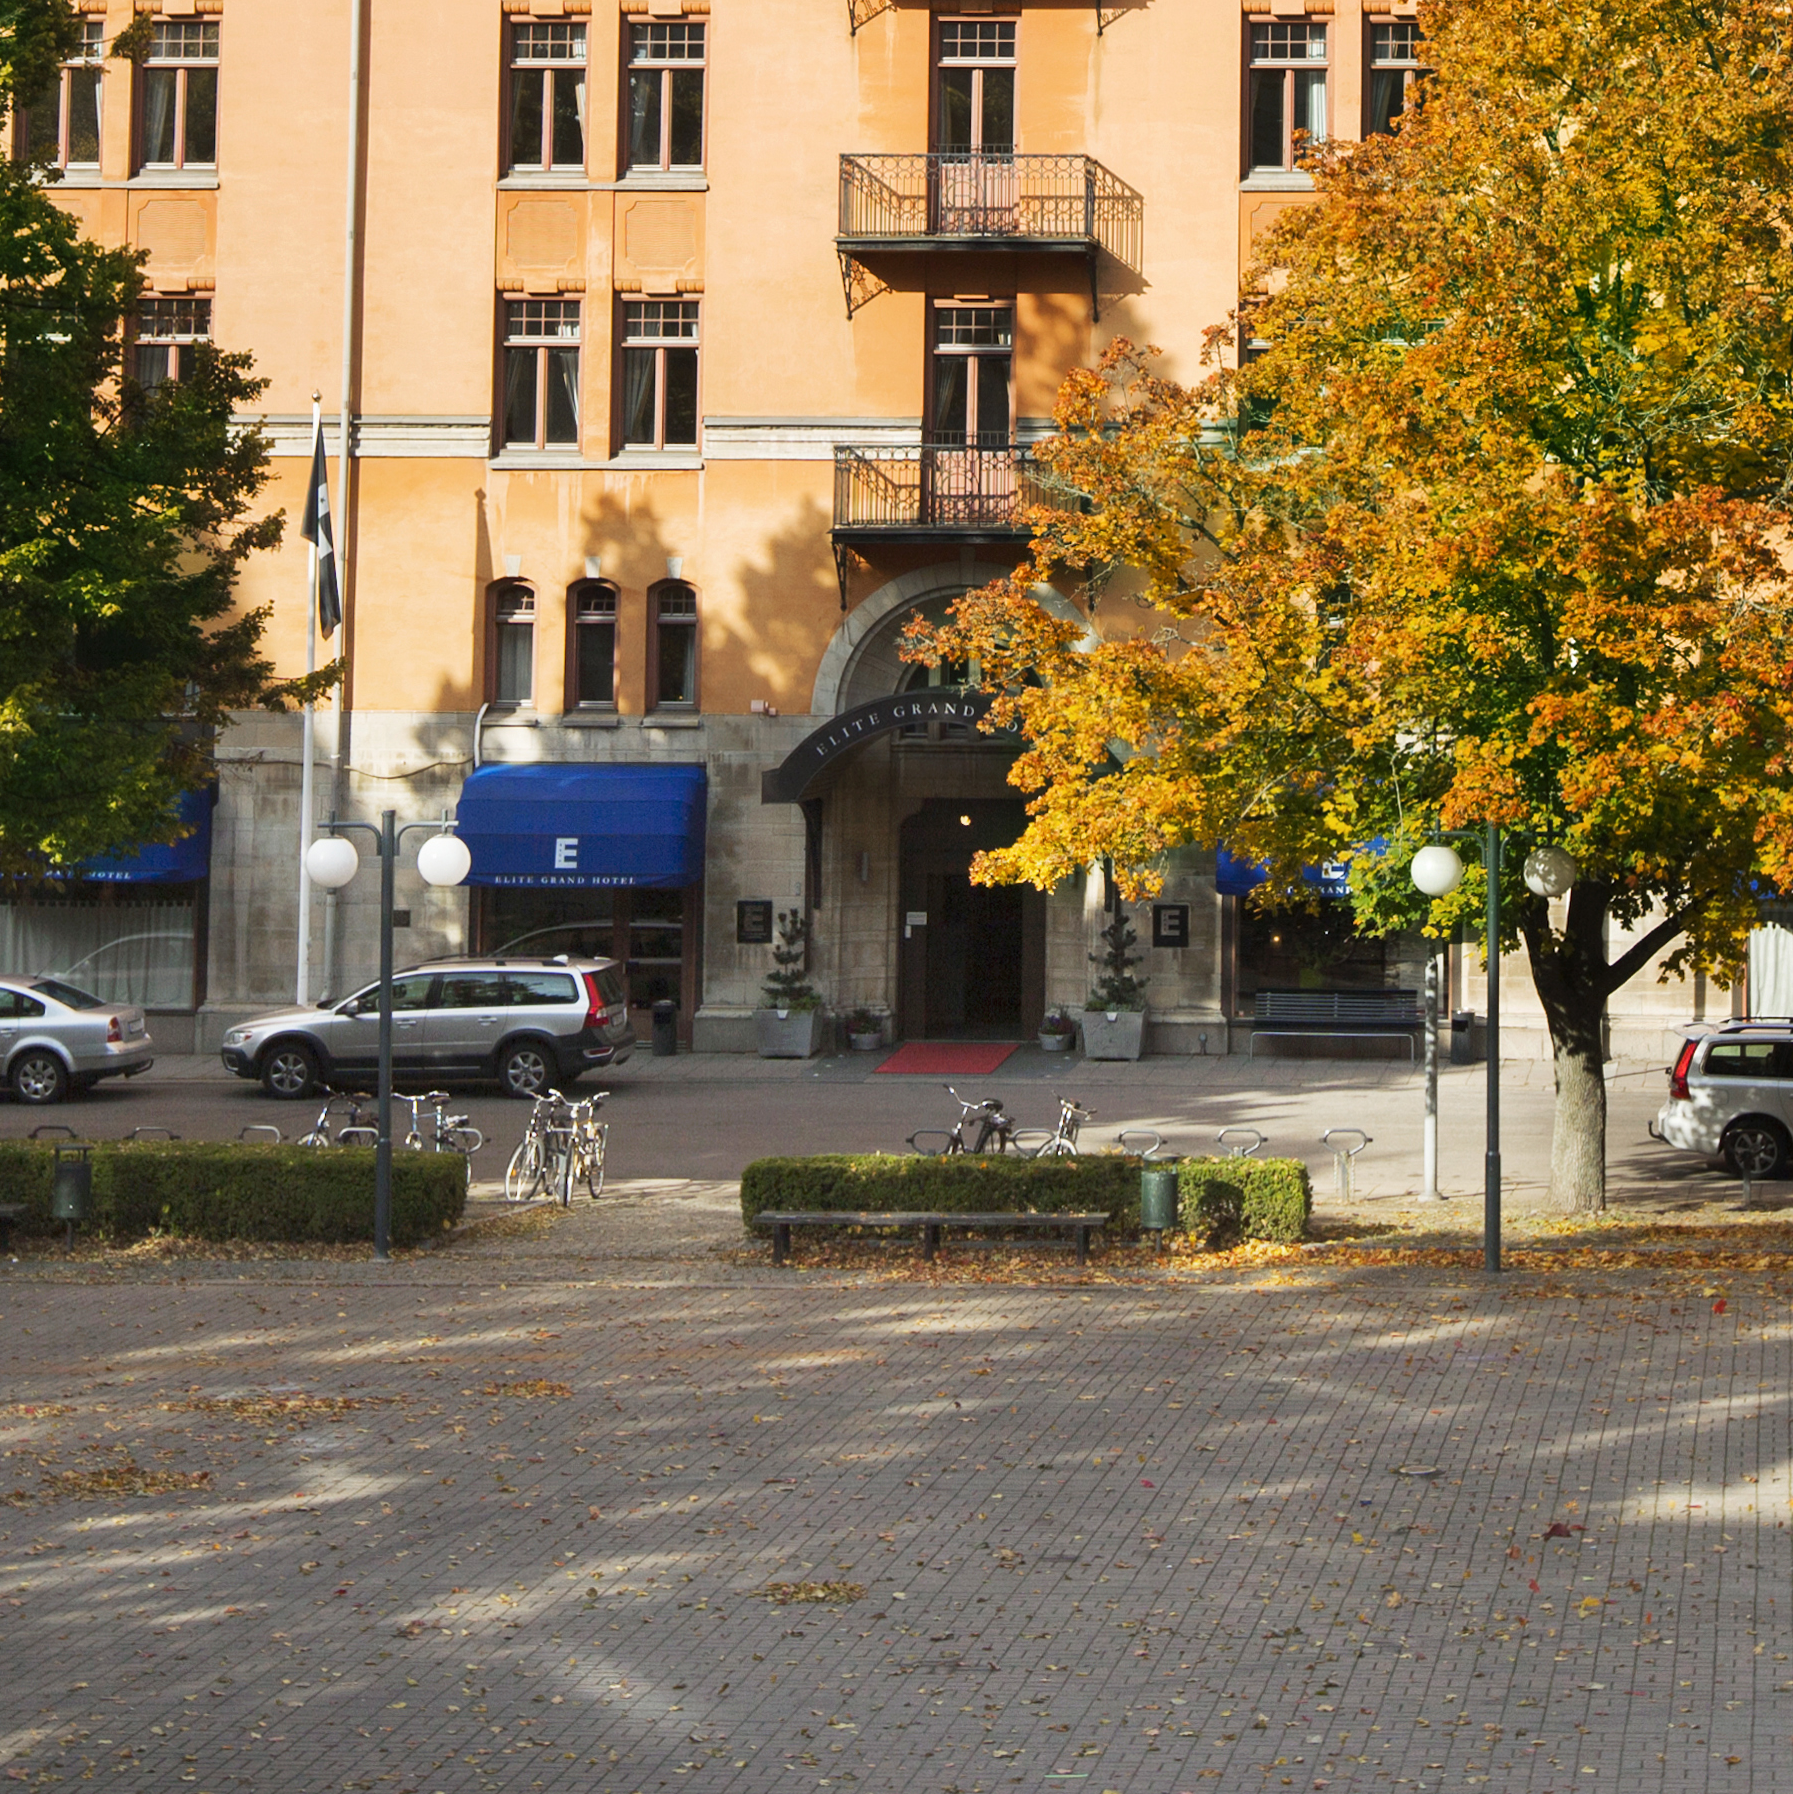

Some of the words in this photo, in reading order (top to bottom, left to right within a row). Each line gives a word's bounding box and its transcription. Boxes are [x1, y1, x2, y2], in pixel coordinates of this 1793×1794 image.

[816, 712, 881, 756] ELITE
[893, 702, 975, 718] GRAND
[555, 838, 578, 869] E
[495, 876, 534, 884] ELITE
[541, 876, 585, 885] GRAND
[592, 877, 636, 885] HOTEL
[744, 905, 764, 932] E
[1160, 909, 1181, 936] E
